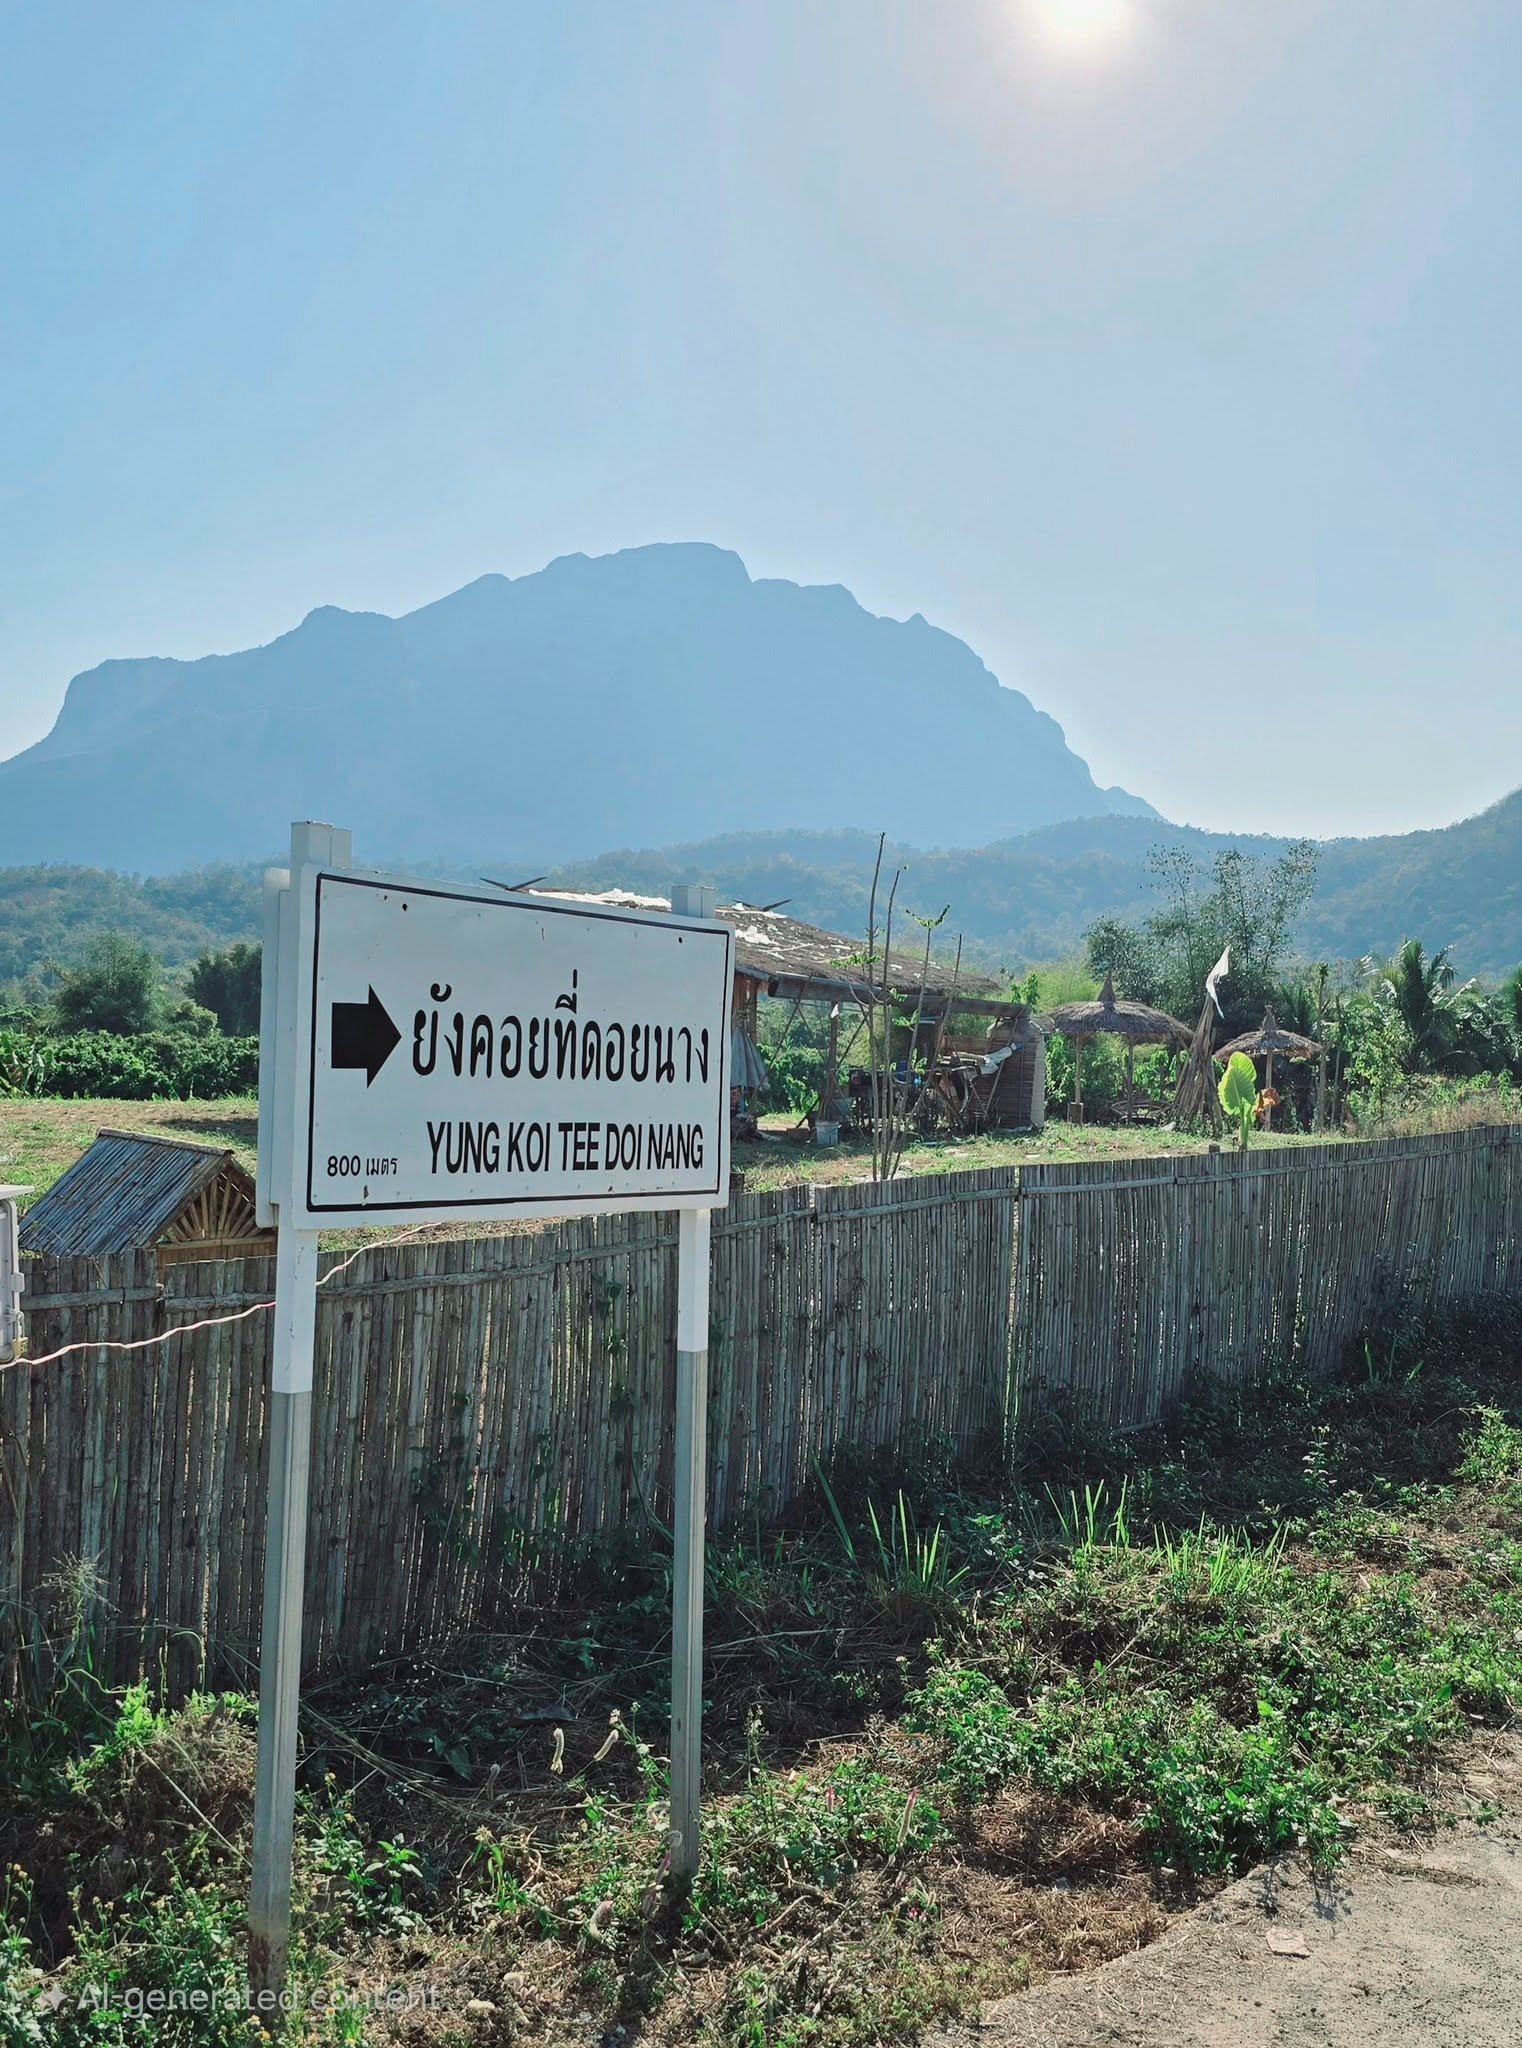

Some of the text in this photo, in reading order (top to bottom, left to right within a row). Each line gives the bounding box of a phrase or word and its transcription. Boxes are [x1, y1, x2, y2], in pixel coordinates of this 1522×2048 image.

[413, 969, 709, 1083] ยังคอยที่ดอยนาง
[327, 1155, 398, 1177] 800 เมตร
[427, 1121, 703, 1173] YUNG KOI TEE DOI NANG
